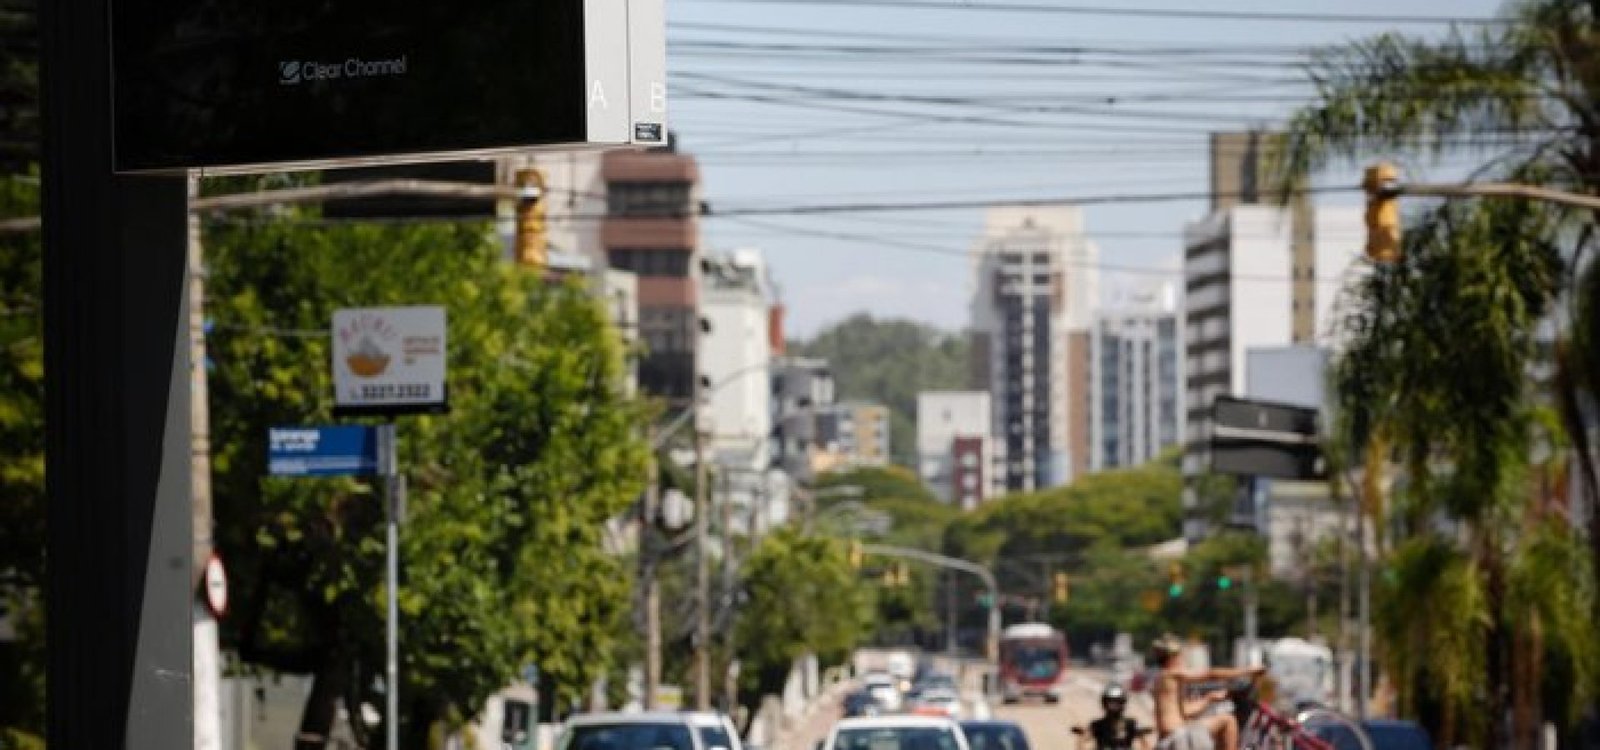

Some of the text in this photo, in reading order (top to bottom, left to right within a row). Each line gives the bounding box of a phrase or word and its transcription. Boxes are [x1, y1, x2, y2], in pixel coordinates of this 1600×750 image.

[303, 54, 407, 80] Clear Channel
[589, 79, 607, 110] A
[650, 81, 666, 112] B
